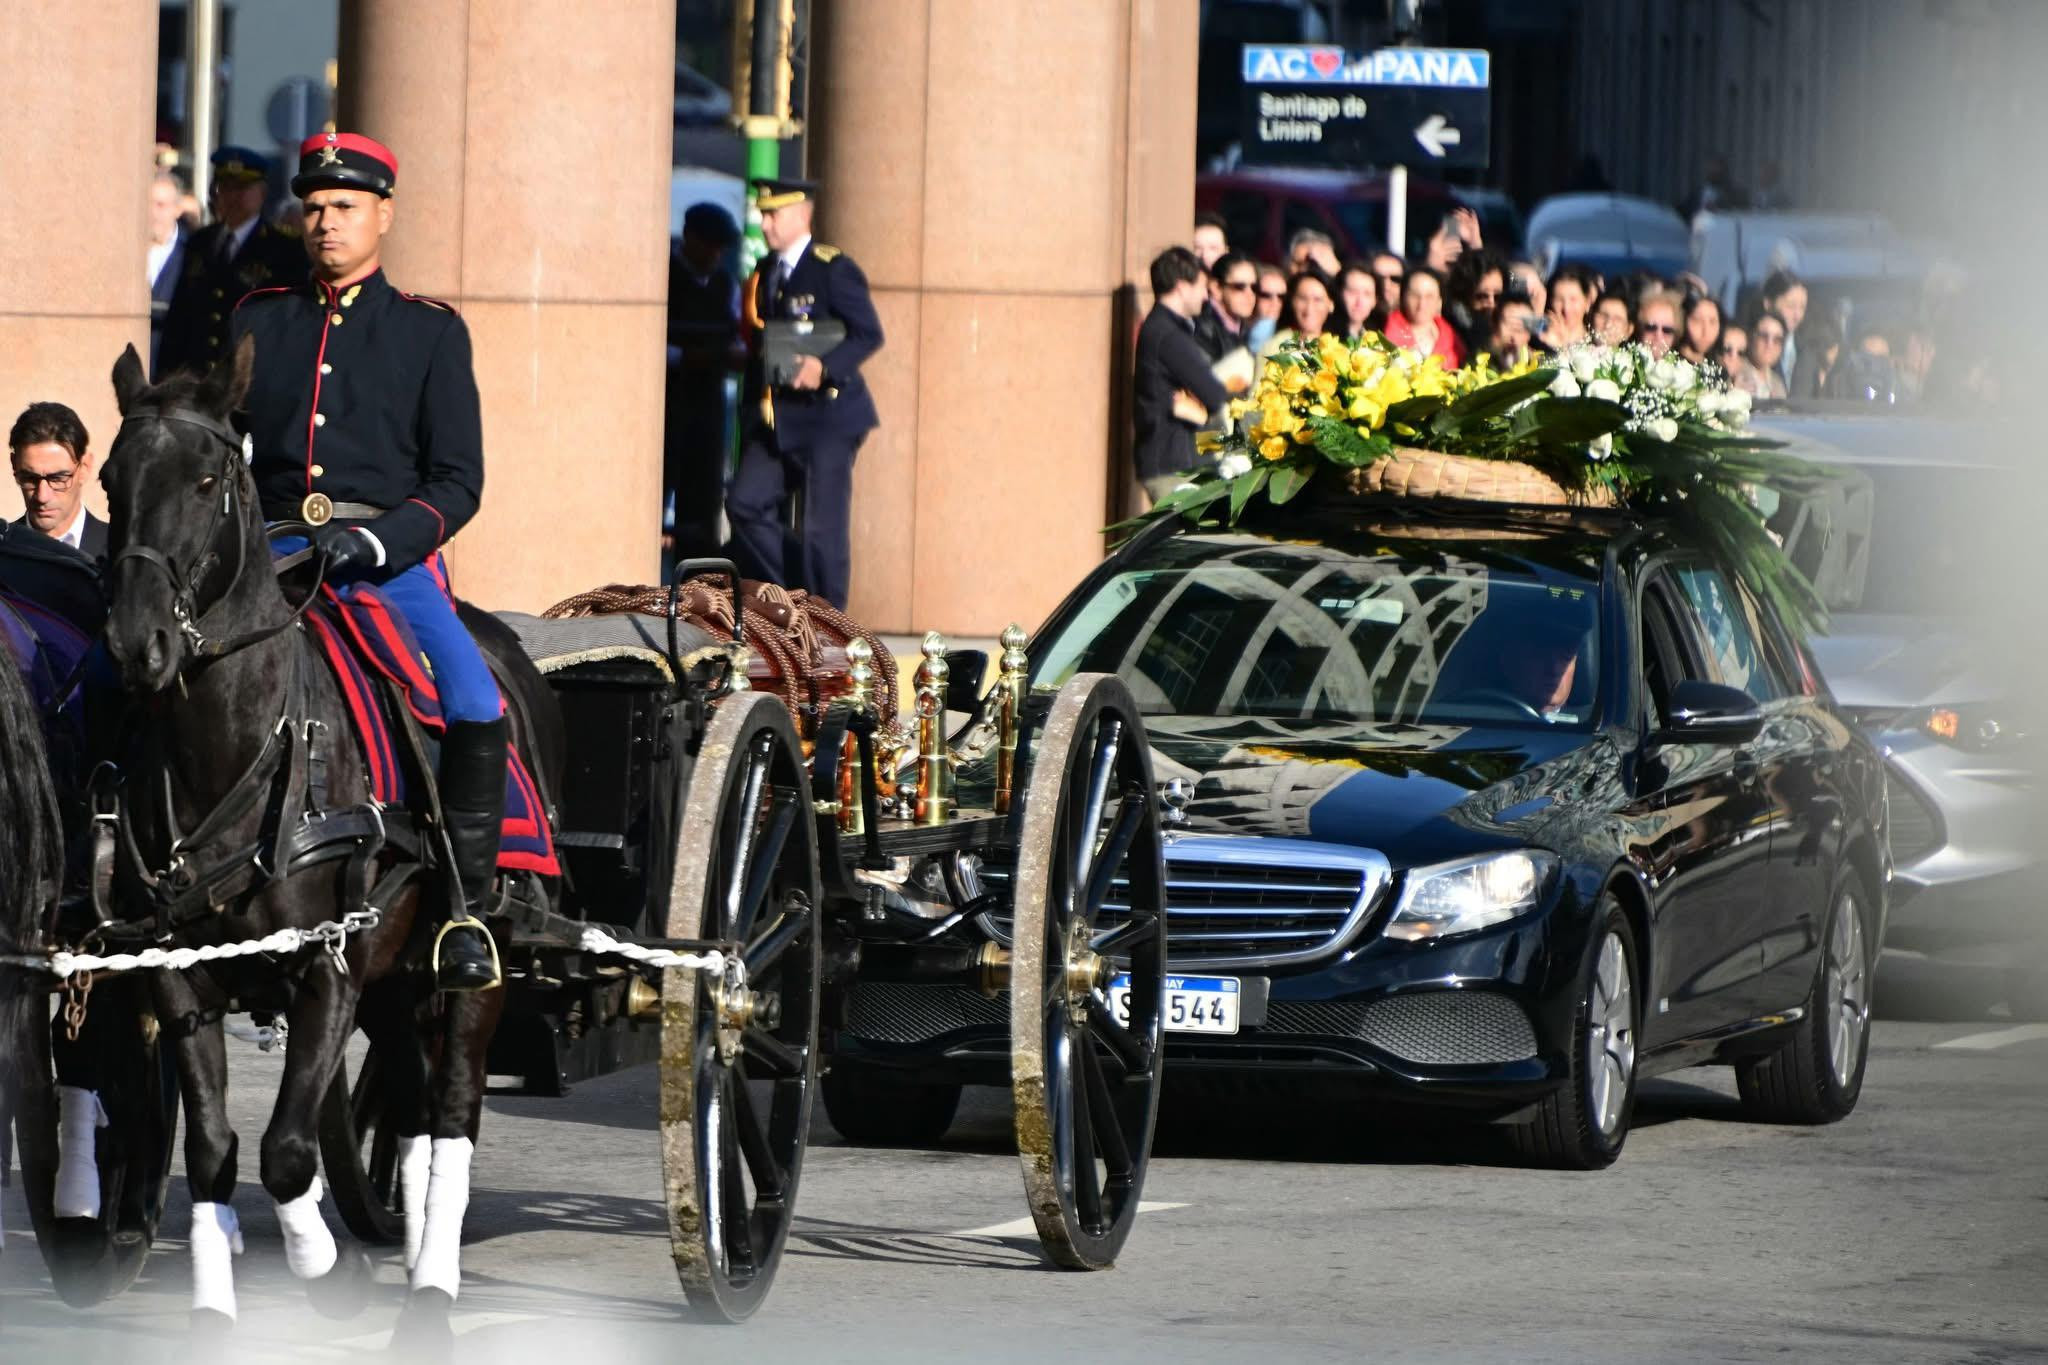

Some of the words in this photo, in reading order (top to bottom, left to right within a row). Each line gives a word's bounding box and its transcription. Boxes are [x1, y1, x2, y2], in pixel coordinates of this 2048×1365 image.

[1260, 91, 1340, 122] Santiago
[1342, 93, 1367, 119] de
[1259, 117, 1322, 142] Liniers
